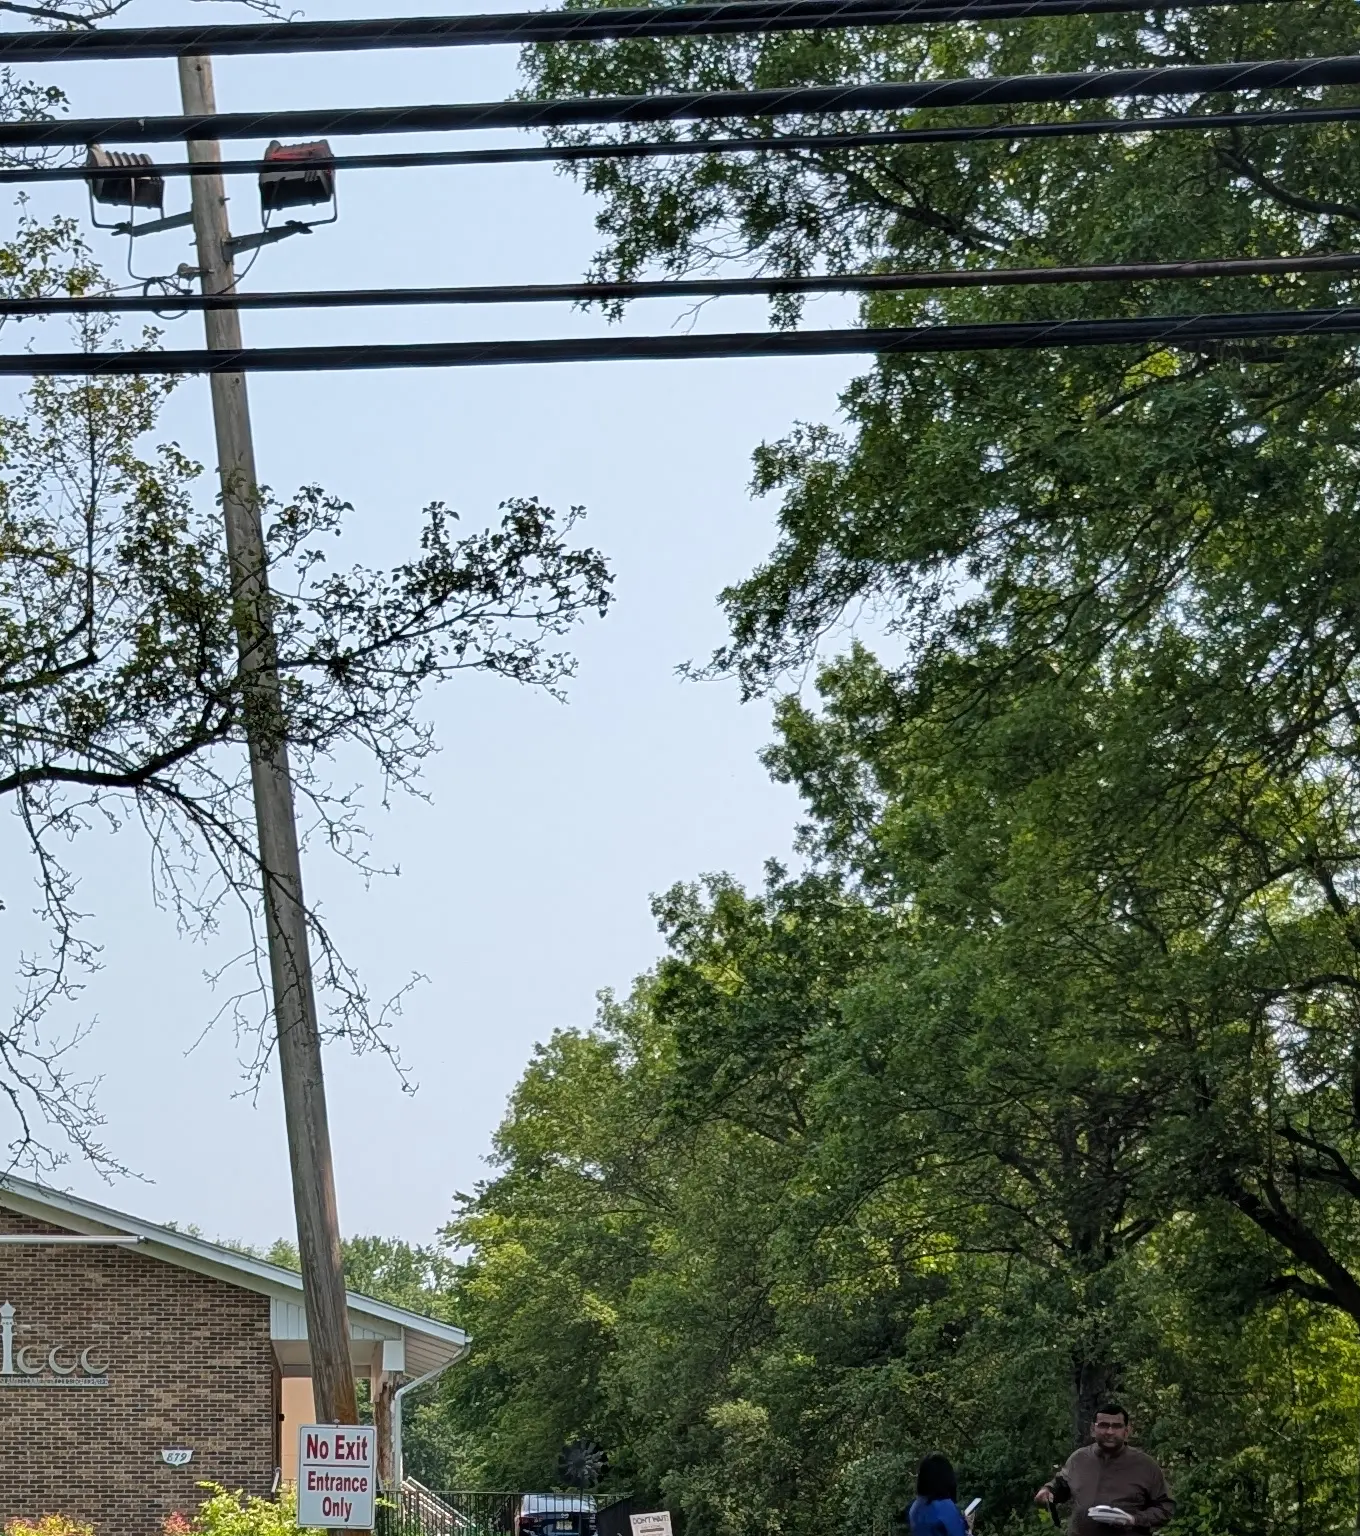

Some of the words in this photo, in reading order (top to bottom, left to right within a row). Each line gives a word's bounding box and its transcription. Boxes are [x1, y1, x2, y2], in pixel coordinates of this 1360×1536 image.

[306, 1434, 329, 1460] No
[335, 1435, 368, 1461] Exit
[307, 1471, 368, 1492] Entrance
[322, 1497, 352, 1522] Only
